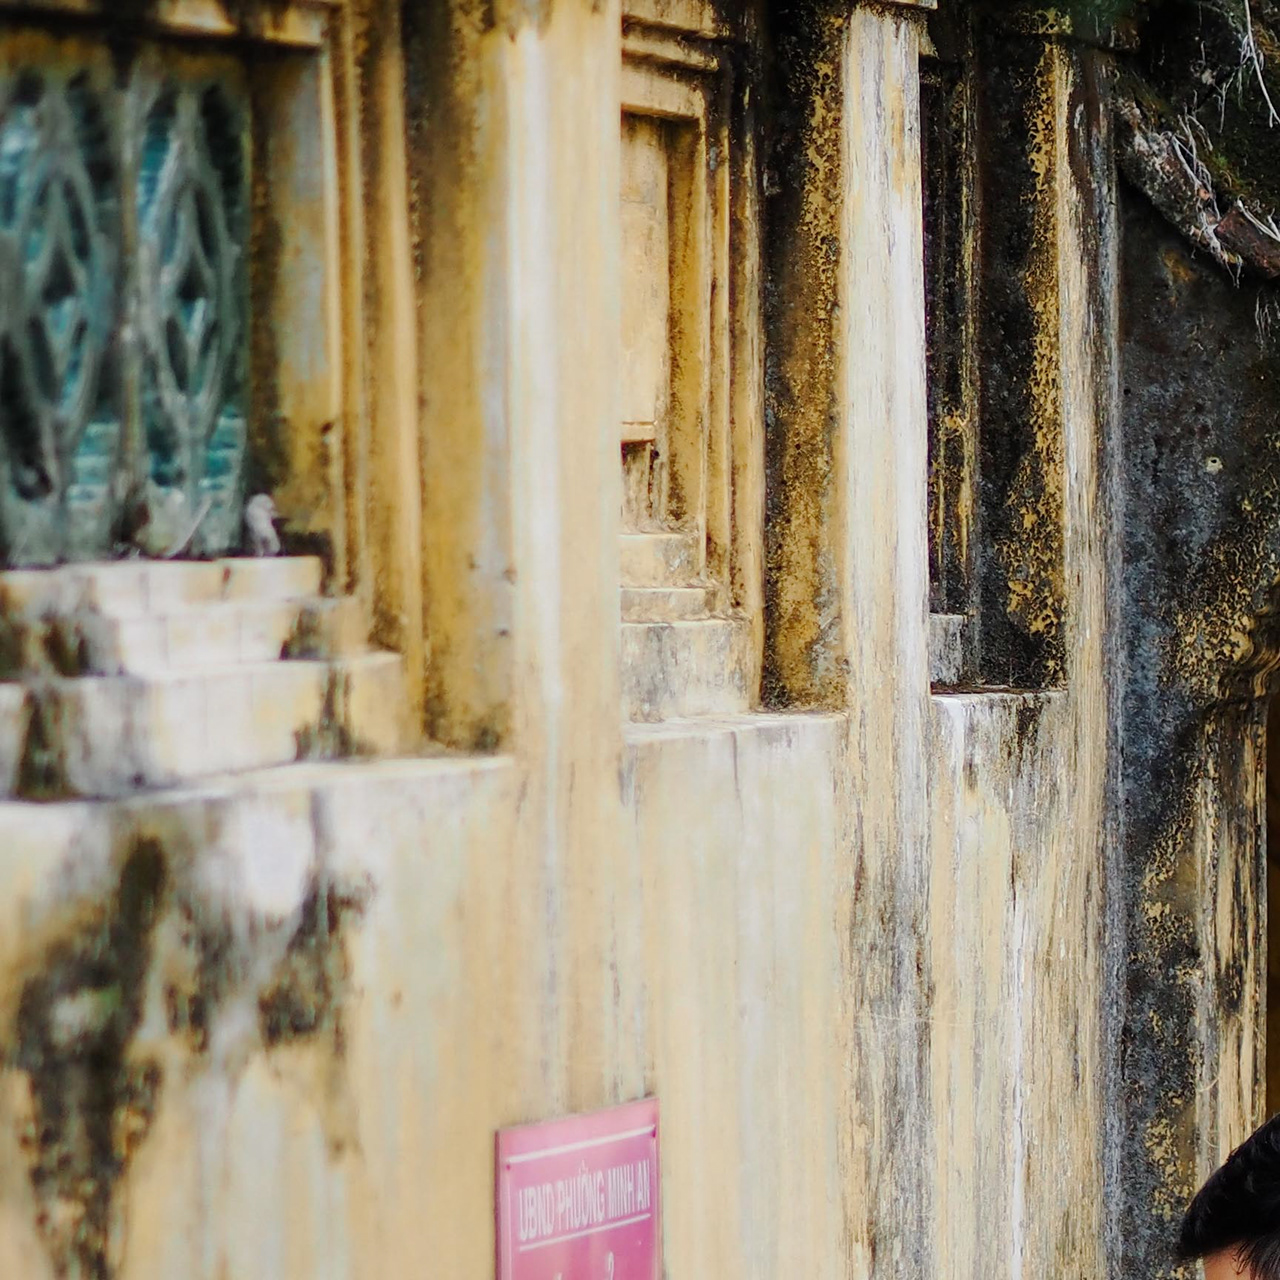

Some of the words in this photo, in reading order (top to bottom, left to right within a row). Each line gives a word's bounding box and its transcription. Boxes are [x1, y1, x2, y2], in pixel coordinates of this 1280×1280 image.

[519, 1182, 555, 1241] UBND
[608, 1164, 634, 1219] MINH
[637, 1158, 651, 1210] AN
